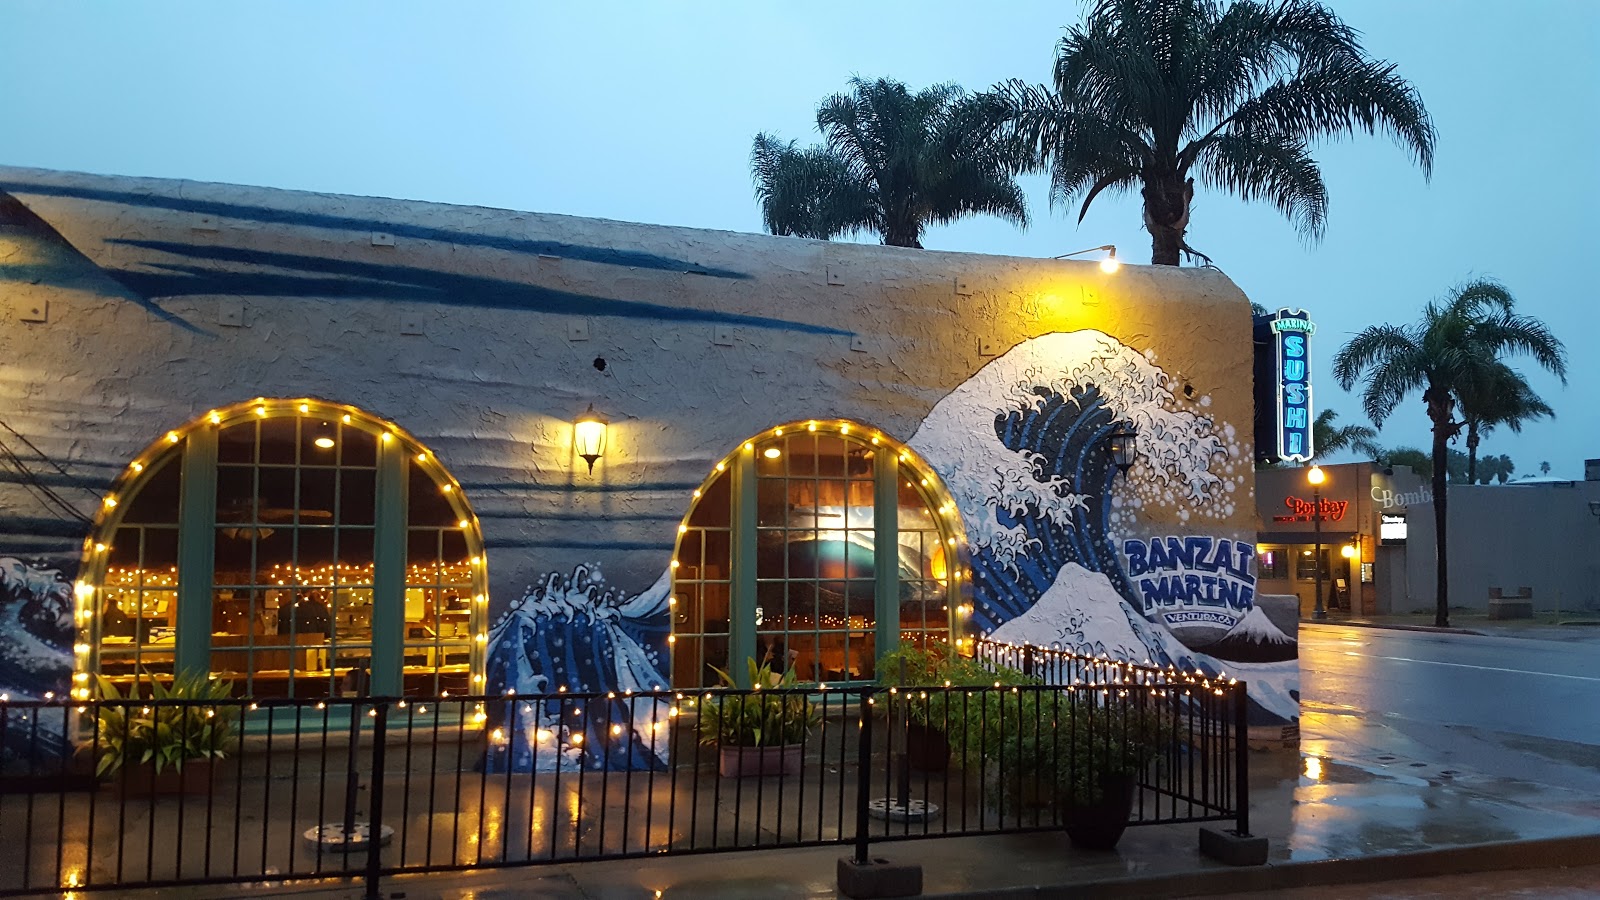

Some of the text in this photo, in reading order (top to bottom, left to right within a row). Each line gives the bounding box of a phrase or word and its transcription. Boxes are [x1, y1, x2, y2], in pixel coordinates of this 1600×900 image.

[1276, 319, 1313, 333] MARINA
[1284, 336, 1306, 453] SUSHI
[1371, 485, 1449, 509] Bomb
[1124, 537, 1255, 585] BANZAI
[1141, 574, 1254, 613] MARINA
